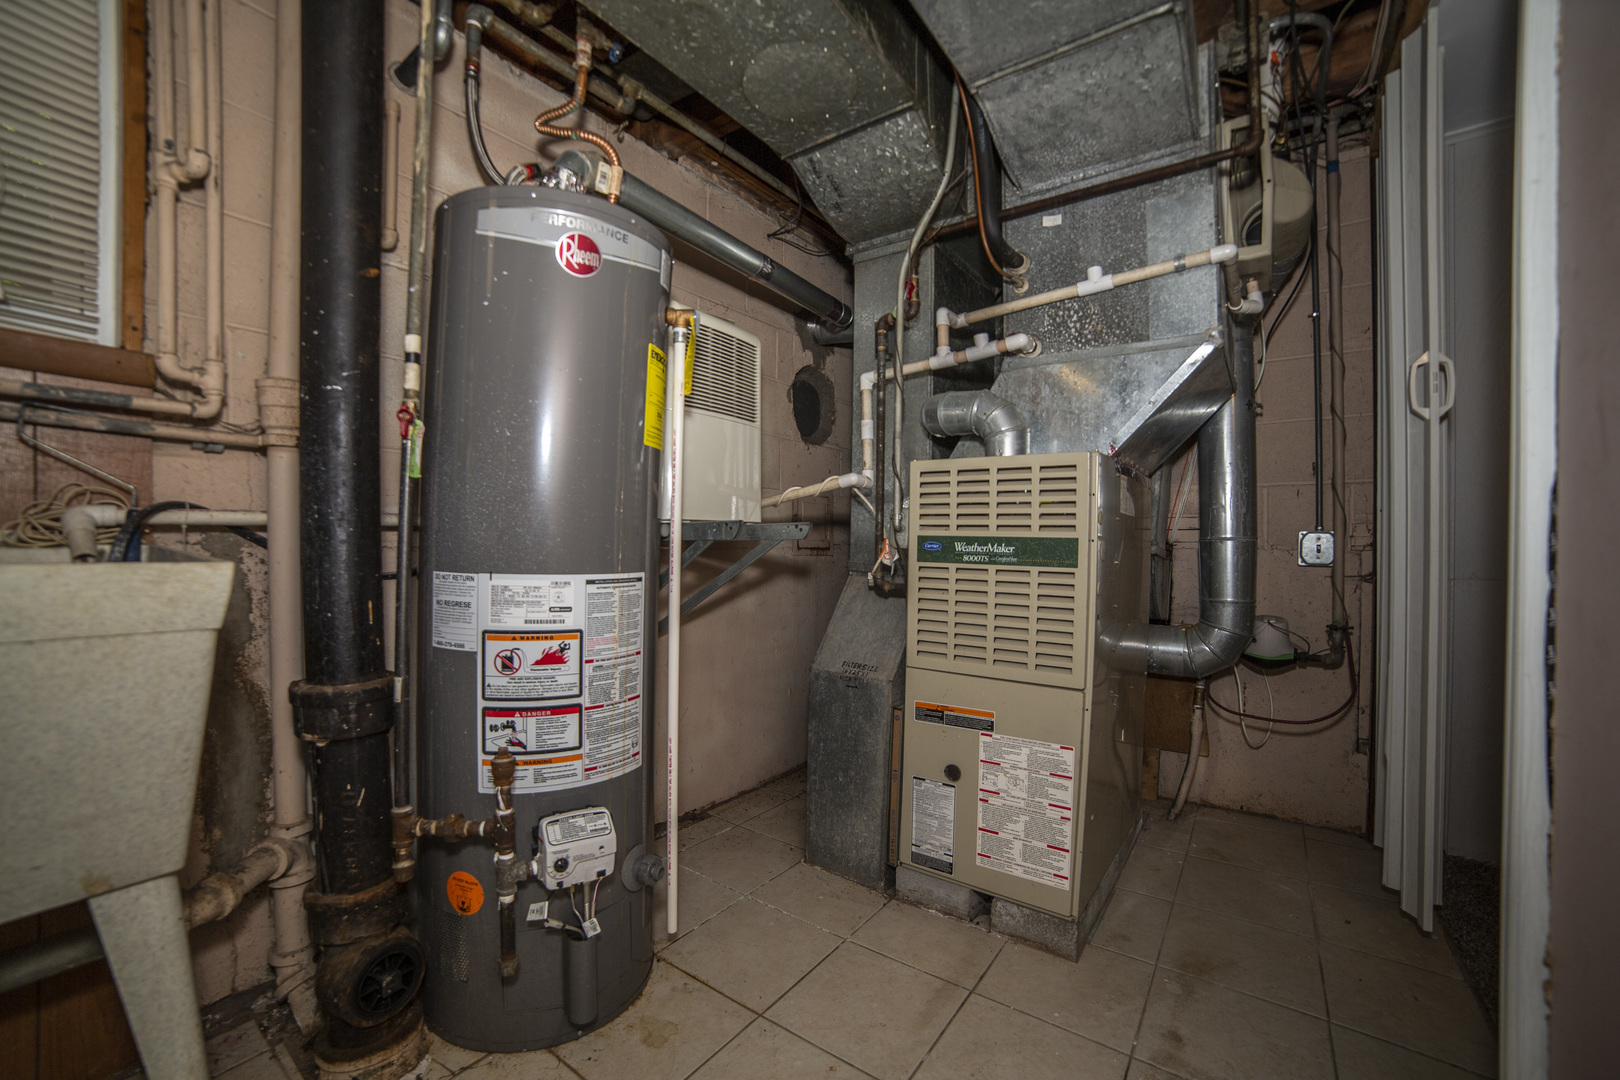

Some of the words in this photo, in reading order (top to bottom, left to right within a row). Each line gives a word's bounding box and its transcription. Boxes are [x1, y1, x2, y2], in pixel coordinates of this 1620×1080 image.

[530, 213, 629, 244] PERFORMANCE
[560, 233, 599, 269] Rheem
[954, 541, 1015, 553] WeatherMaker
[962, 554, 989, 562] 8000TS
[441, 573, 451, 581] NOT
[452, 574, 475, 582] RETURN
[444, 600, 472, 608] REGRESE
[841, 660, 862, 670] FILTER
[861, 663, 879, 673] SIZE
